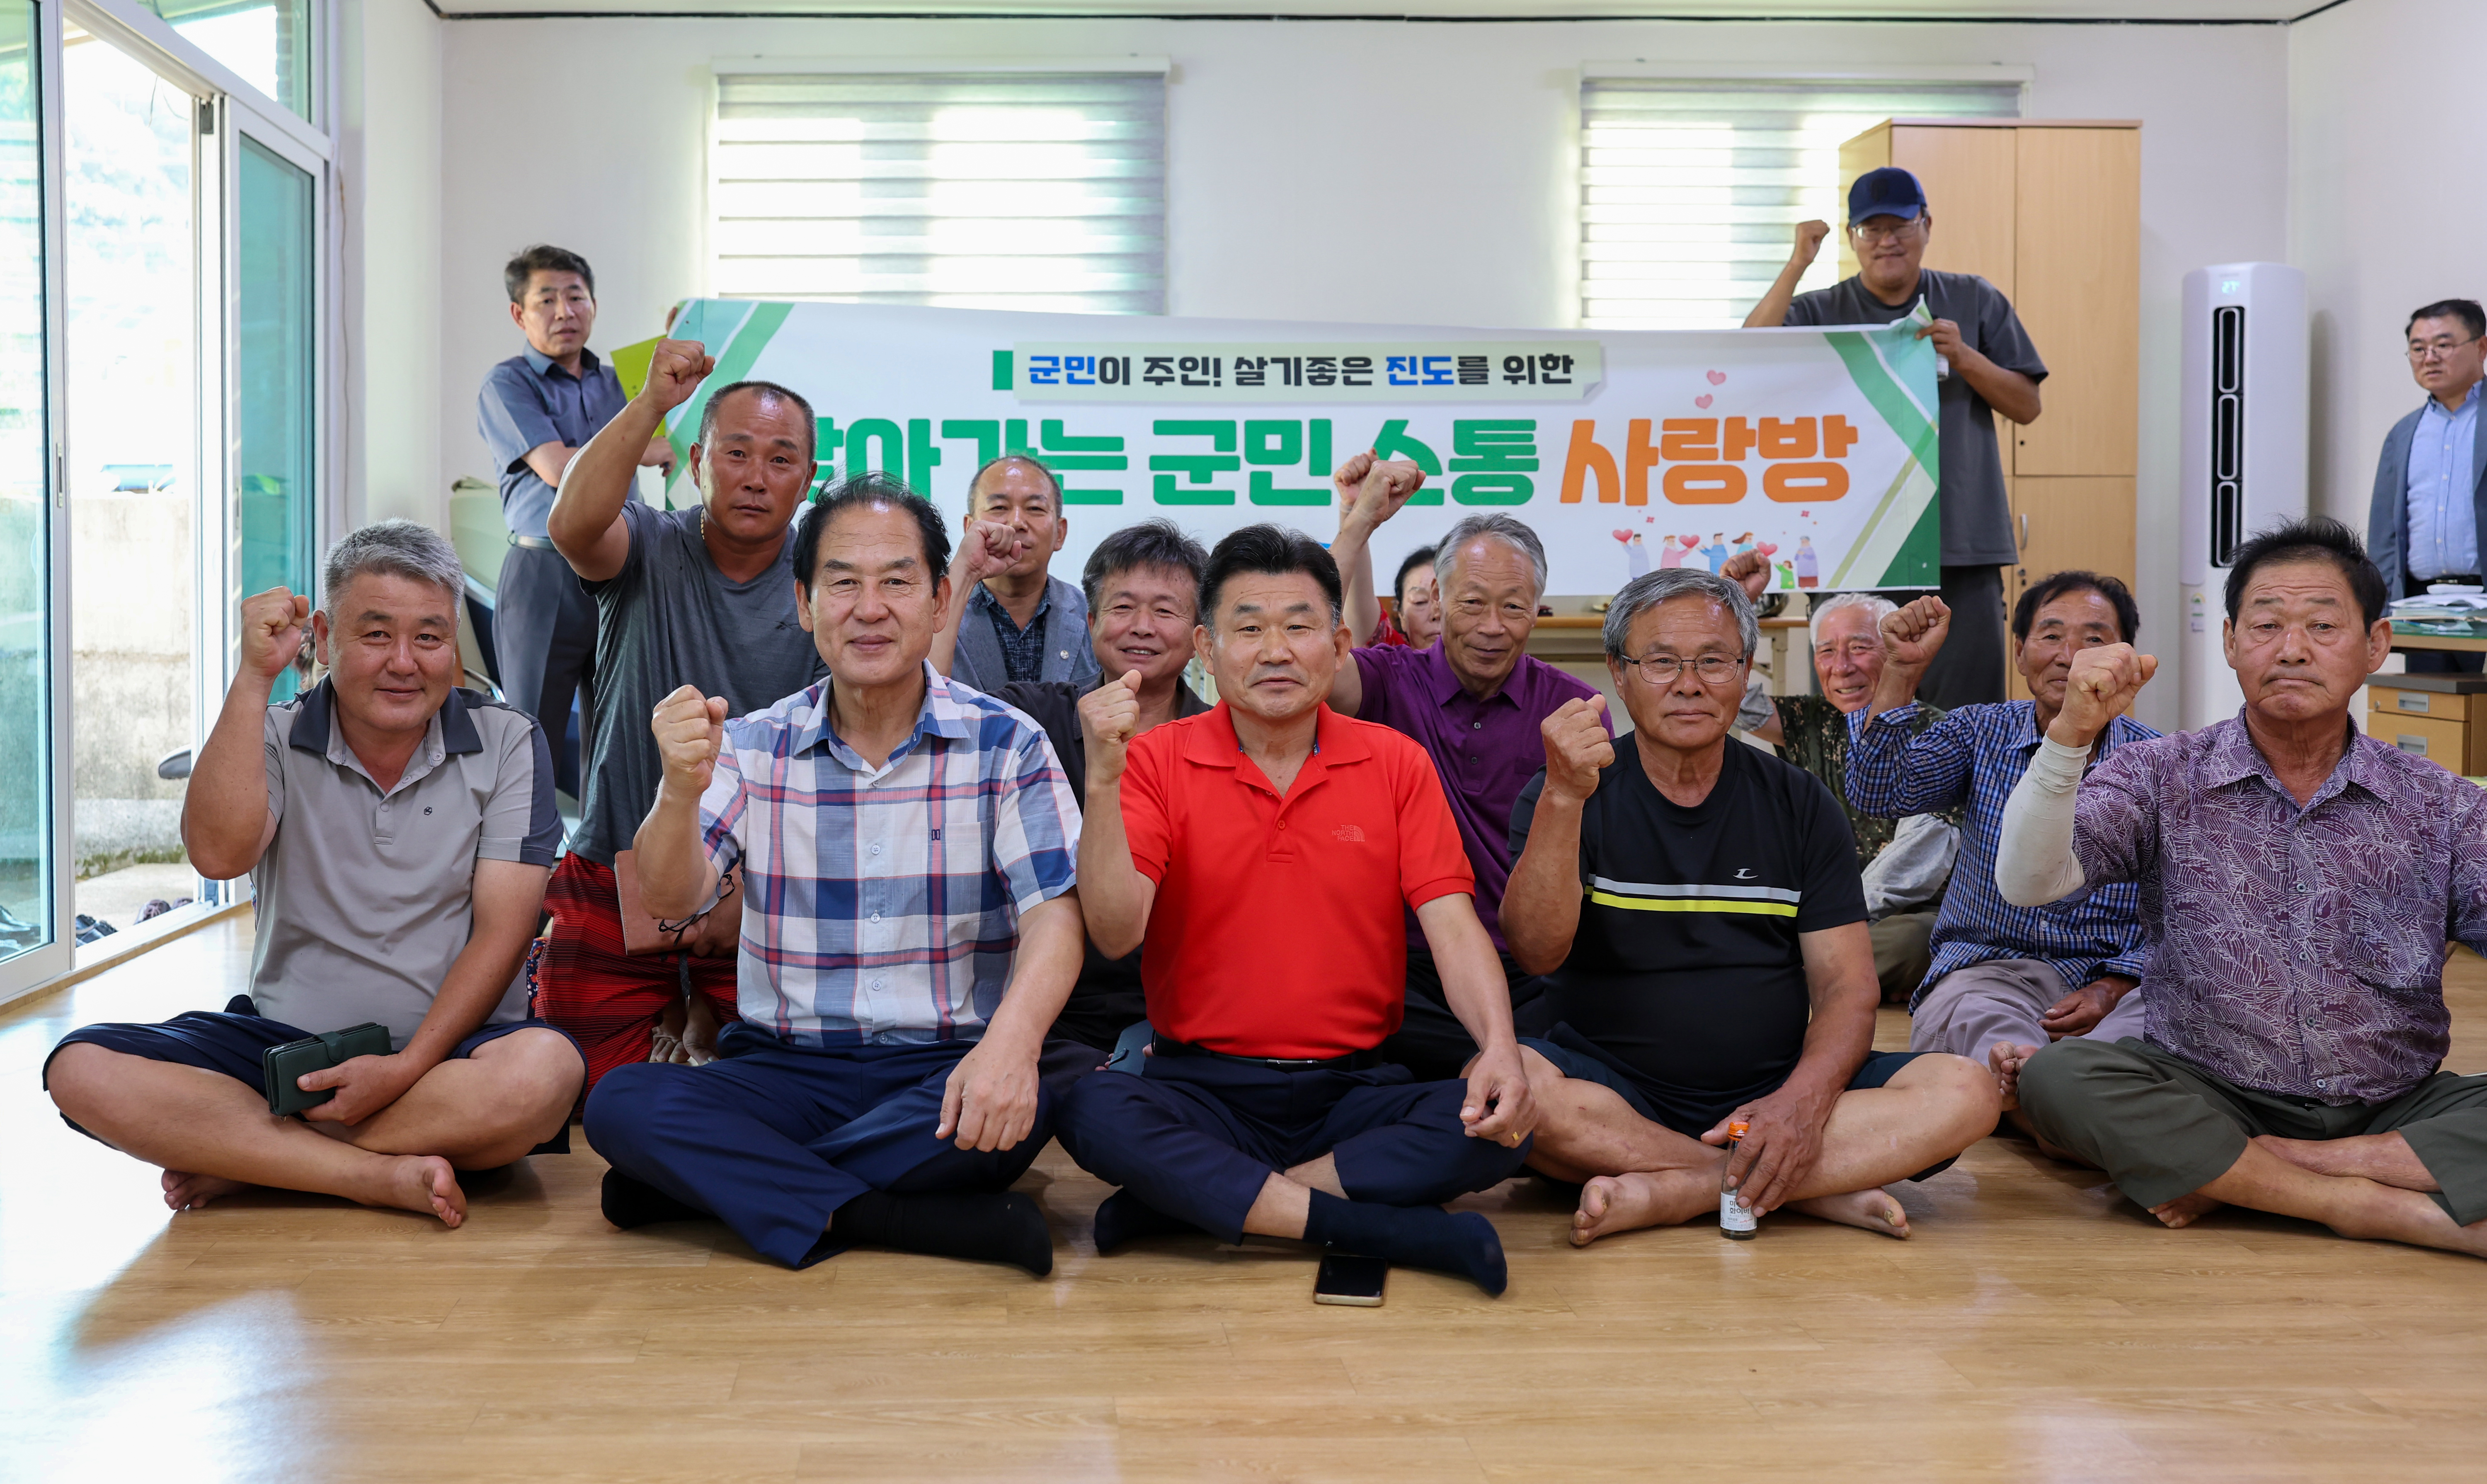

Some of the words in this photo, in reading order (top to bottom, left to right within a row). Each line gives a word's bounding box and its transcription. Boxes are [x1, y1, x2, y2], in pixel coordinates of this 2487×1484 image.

[1029, 356, 1130, 386] 군민이
[1143, 356, 1221, 387] 주인!
[1234, 356, 1374, 386] 살기좋은
[1386, 356, 1489, 386] 진도를
[1503, 353, 1574, 385] 위한
[1149, 419, 1332, 506] 군민
[1560, 415, 1858, 506] 사랑방
